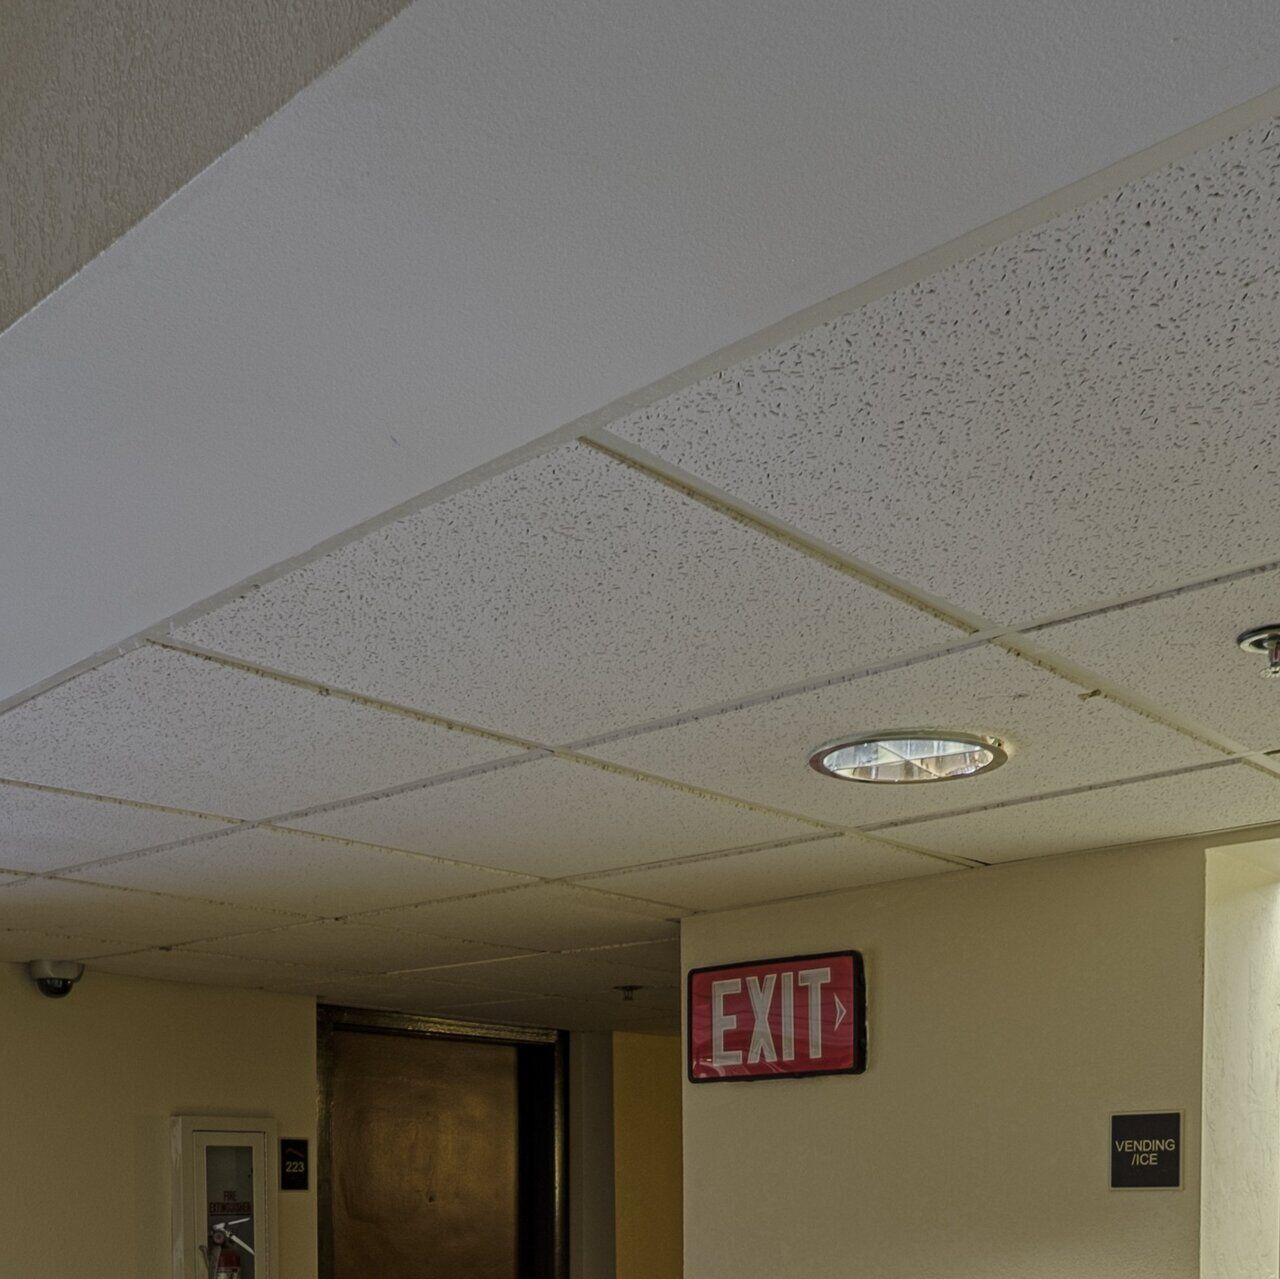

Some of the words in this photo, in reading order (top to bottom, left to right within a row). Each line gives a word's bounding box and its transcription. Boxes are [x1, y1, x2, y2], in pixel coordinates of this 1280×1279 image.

[712, 967, 831, 1067] EXIT
[1115, 1138, 1176, 1152] VENDING
[1131, 1153, 1159, 1166] /ICE
[285, 1161, 305, 1173] 223
